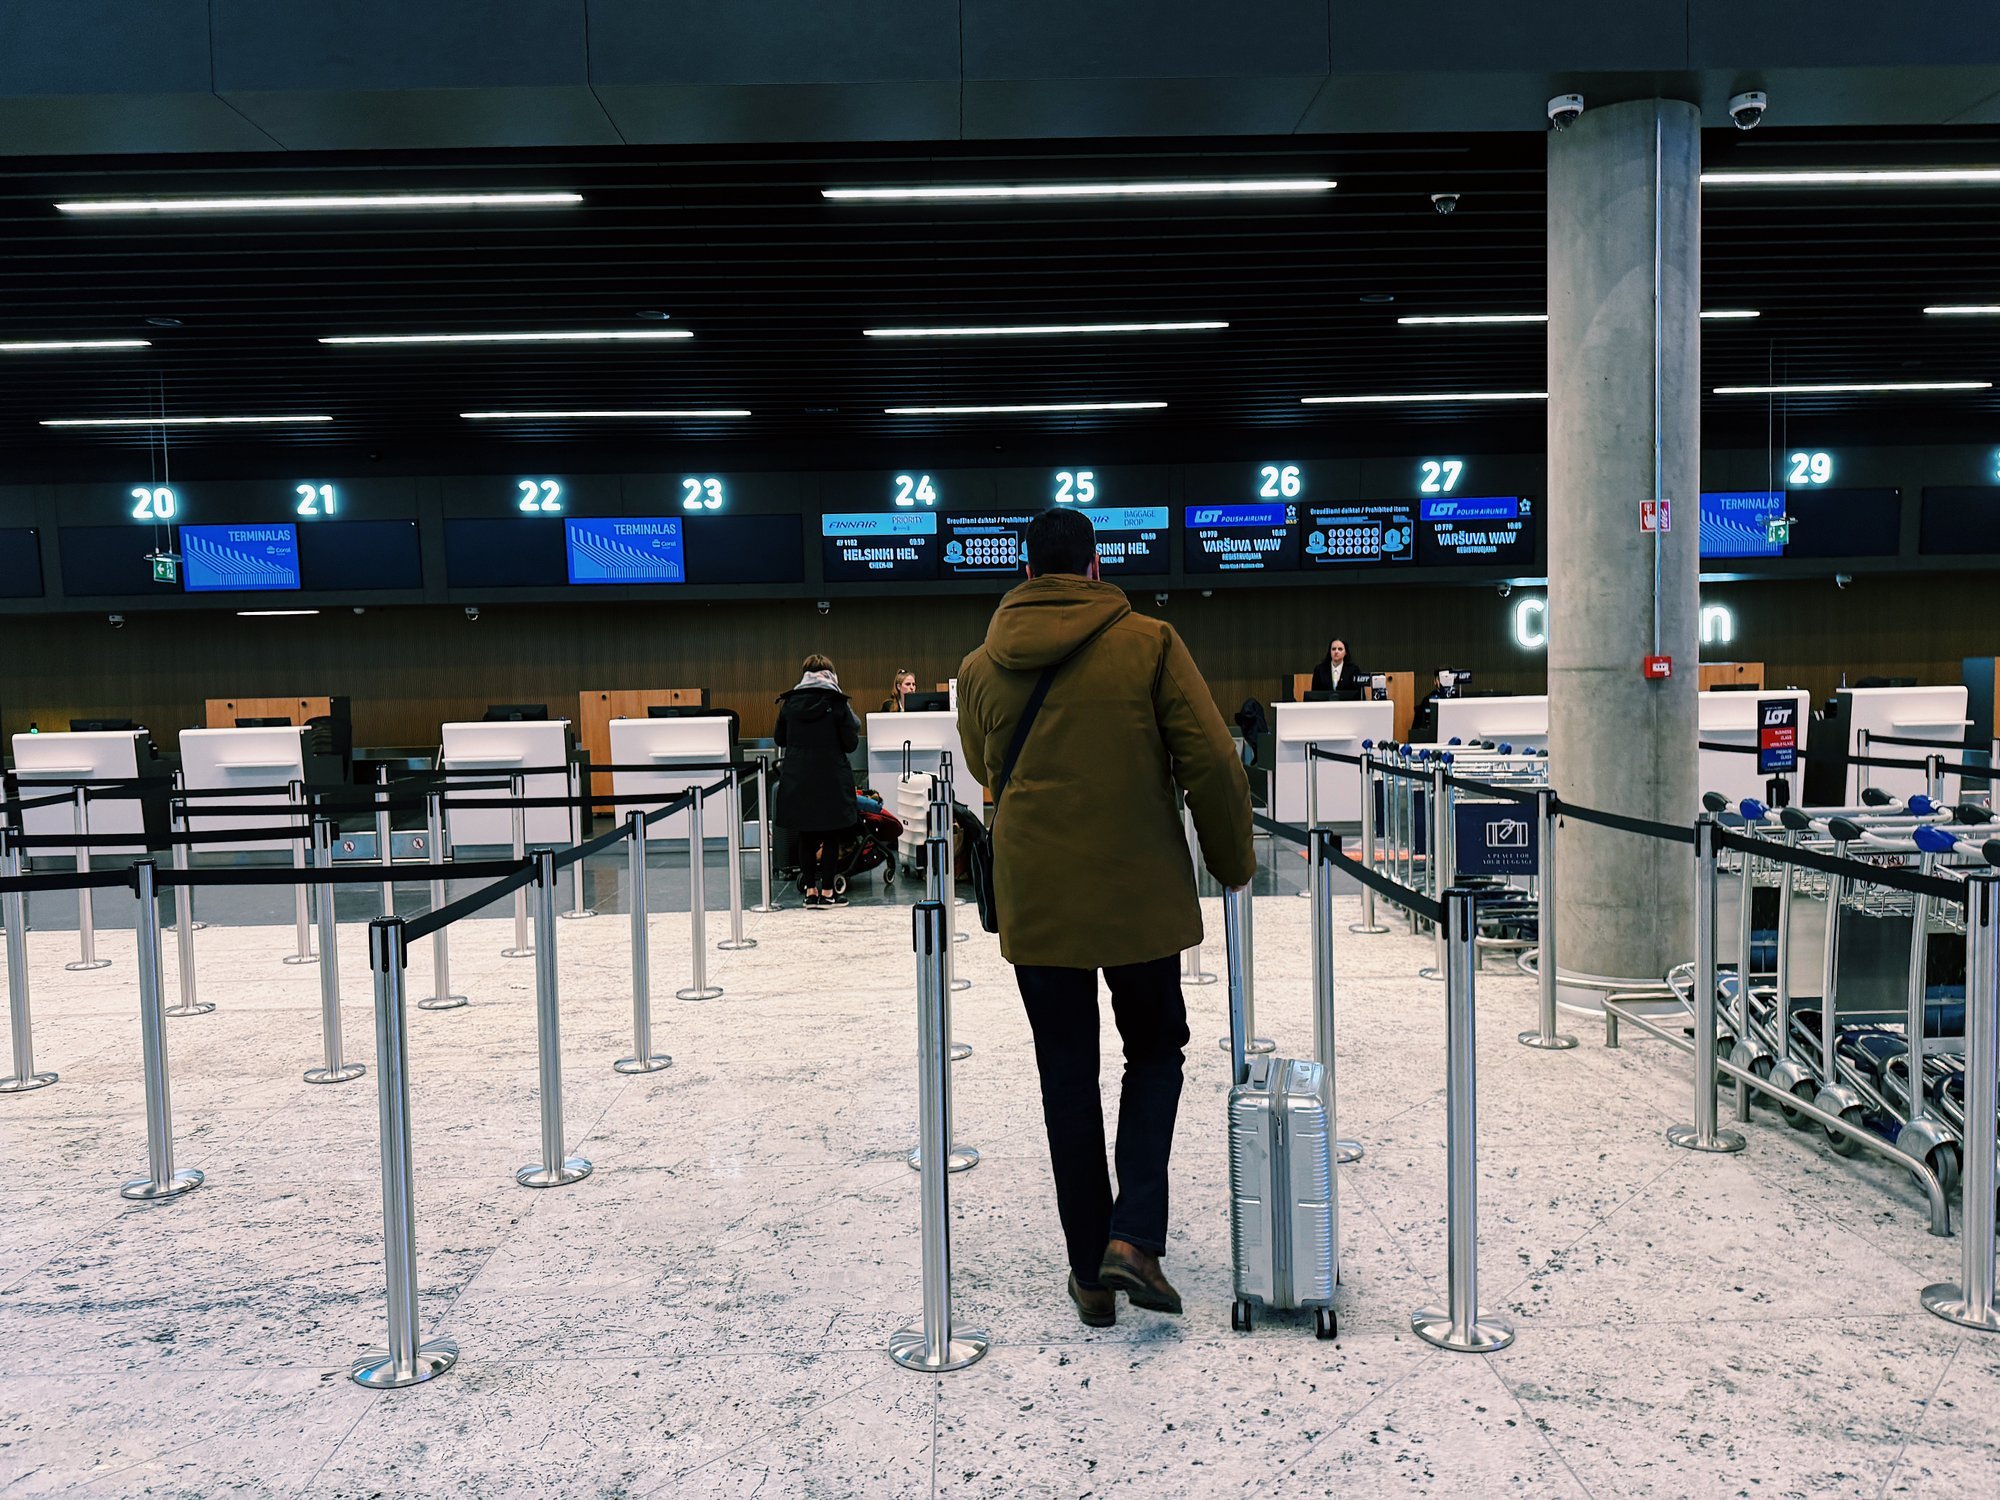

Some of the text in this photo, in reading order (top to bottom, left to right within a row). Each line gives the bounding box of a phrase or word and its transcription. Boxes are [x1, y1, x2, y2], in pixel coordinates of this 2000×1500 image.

[1789, 452, 1831, 484] 29
[1259, 465, 1301, 497] 26
[1420, 461, 1463, 492] 27
[682, 478, 723, 510] 23
[895, 475, 936, 506] 24
[1055, 471, 1095, 503] 25
[131, 487, 175, 518] 20
[296, 483, 335, 516] 21
[518, 480, 561, 511] 22
[1365, 506, 1393, 514] Prohibited
[1429, 502, 1508, 517] LOT POLISH AIRLINES
[1720, 498, 1780, 511] TERMINALAS
[892, 515, 923, 525] PRIORITY
[1124, 510, 1155, 519] BAGGAGE
[1194, 510, 1272, 524] LOT POLISH AIRLINES
[613, 523, 677, 536] TERMINALAS
[829, 520, 877, 529] FINNAIR
[1124, 519, 1144, 528] DROP
[227, 529, 291, 543] TERMINALAS
[1437, 530, 1517, 546] VARŠUVA WAW
[1096, 542, 1150, 555] SINKI HEL
[1203, 538, 1281, 553] VARŠUVA WAW
[843, 547, 919, 561] HELSINKI HEL
[1764, 708, 1793, 725] LOT
